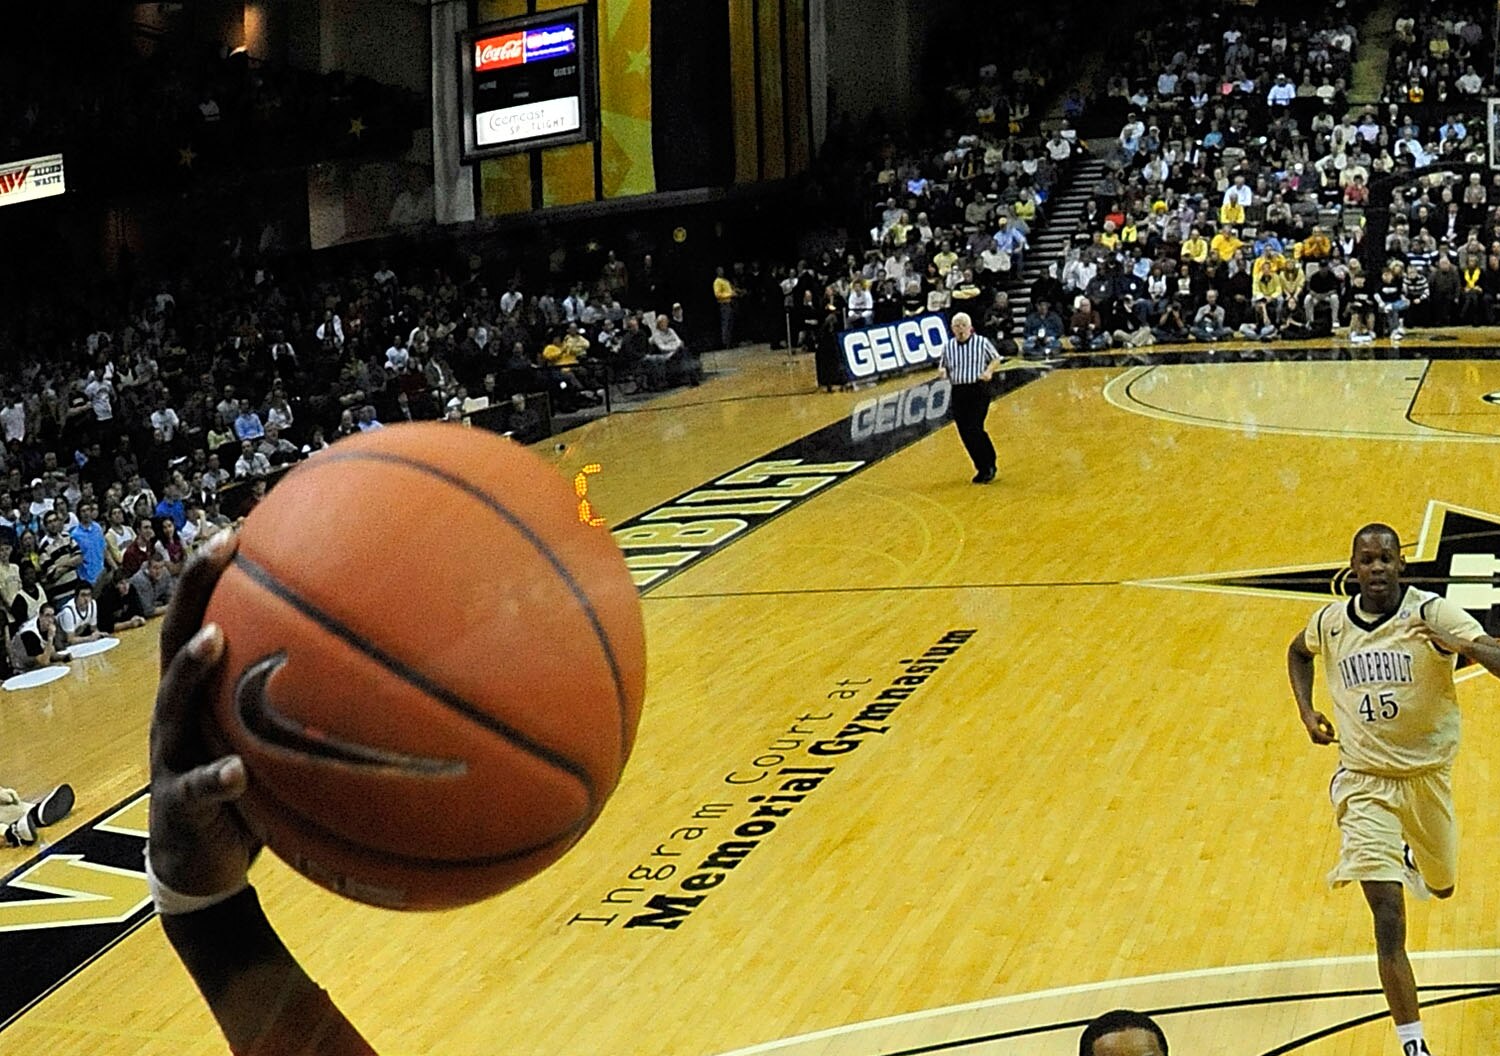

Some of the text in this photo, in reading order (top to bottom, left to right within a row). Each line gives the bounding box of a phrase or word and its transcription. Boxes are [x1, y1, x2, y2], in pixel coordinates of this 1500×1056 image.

[844, 315, 949, 377] GEICO
[1337, 652, 1413, 690] VANDERBILT
[1358, 692, 1399, 723] 45
[567, 677, 873, 927] Ingram Court at
[623, 628, 978, 931] Memorial Gymnasium
